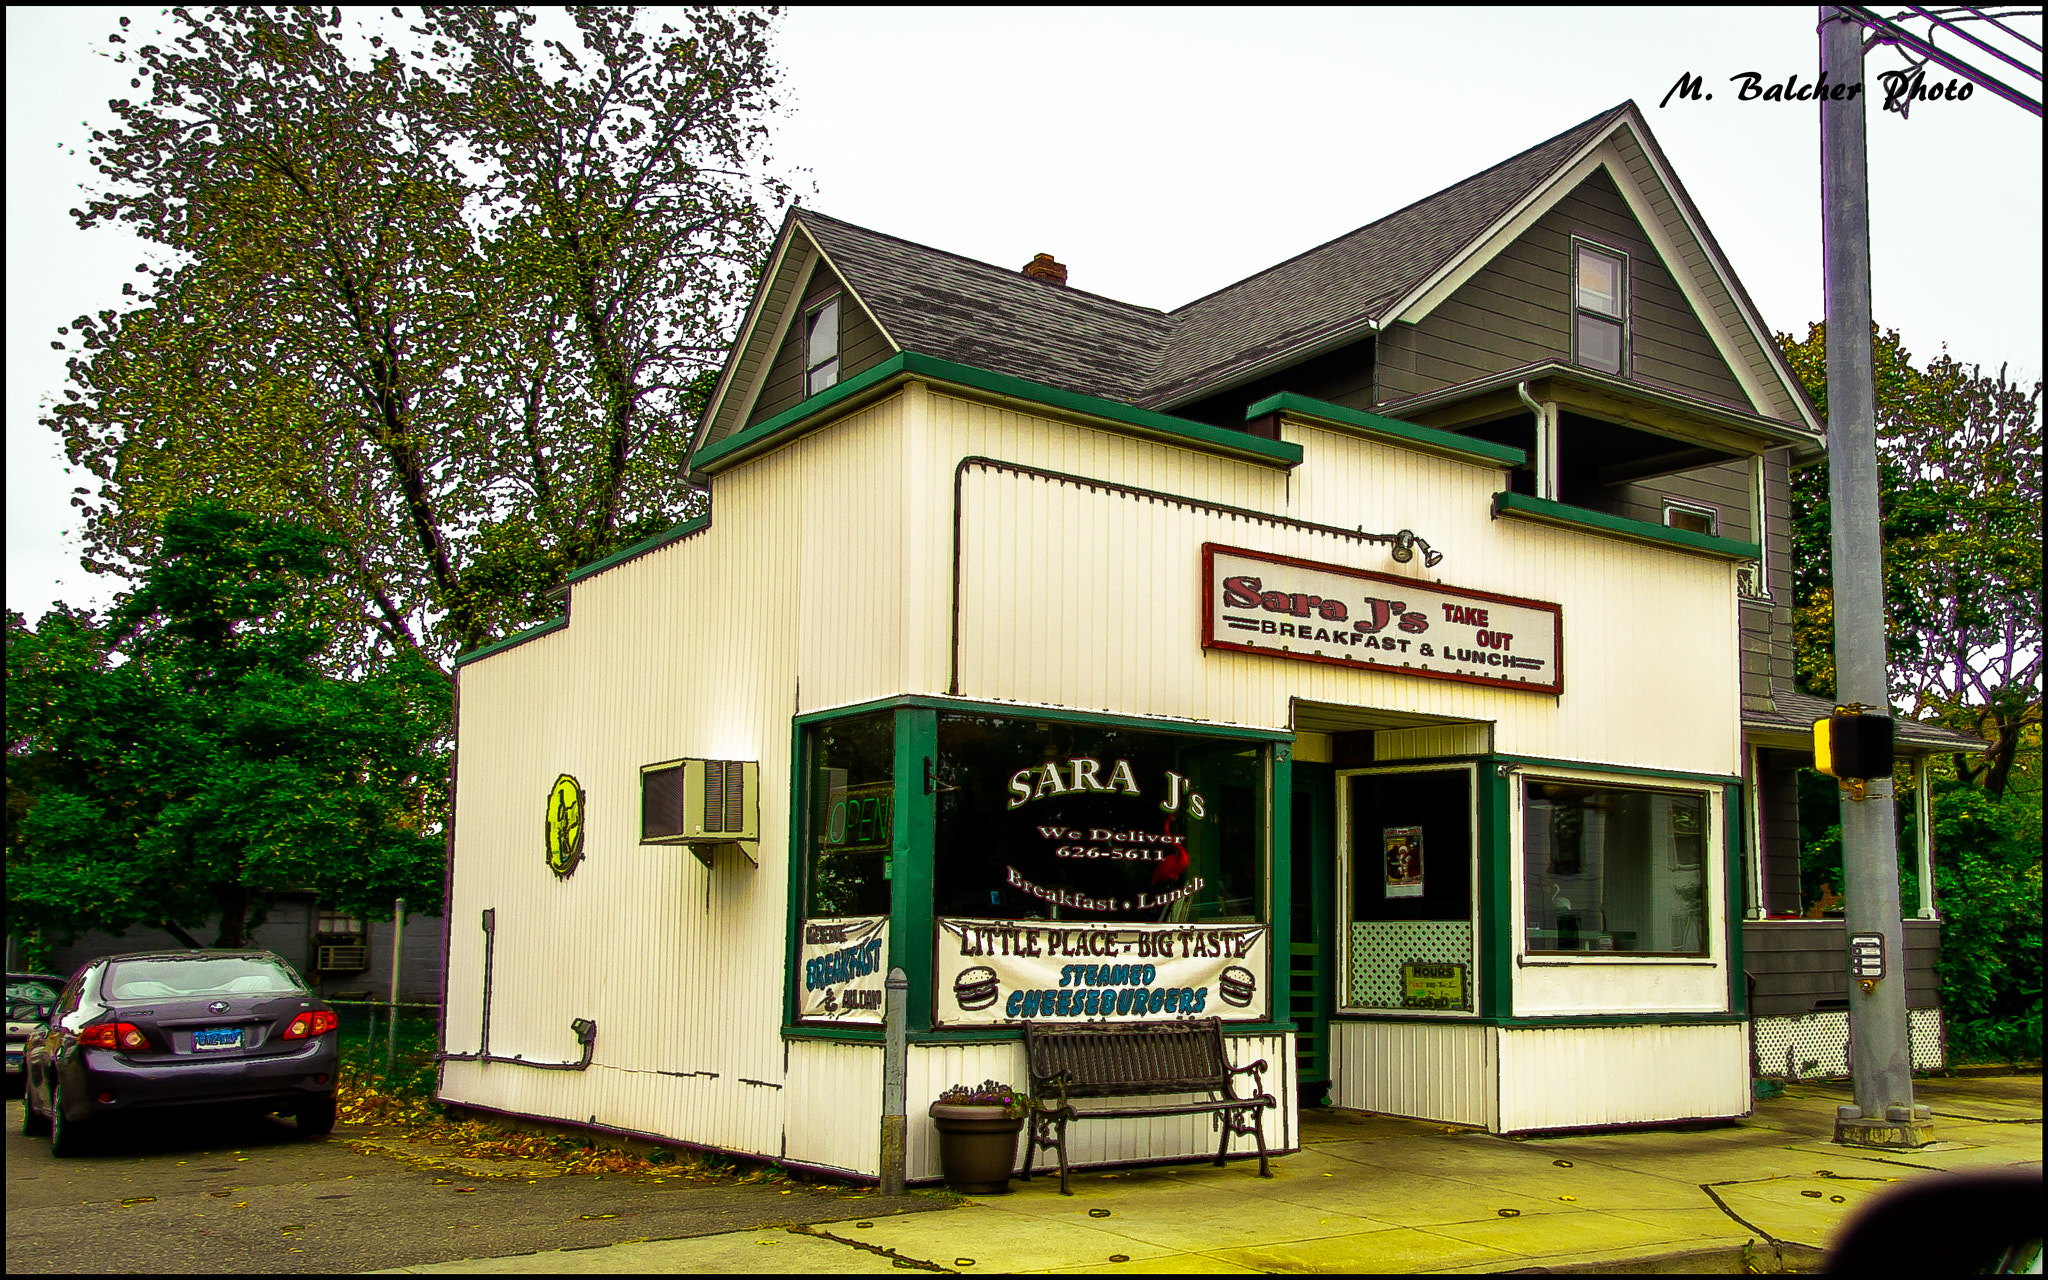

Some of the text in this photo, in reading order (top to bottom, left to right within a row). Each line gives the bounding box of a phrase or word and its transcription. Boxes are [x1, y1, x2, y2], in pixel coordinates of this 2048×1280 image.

[1223, 576, 1430, 634] Sara J's
[1442, 603, 1489, 628] TAKE
[1260, 619, 1517, 669] BREAKFAST & LUNCH
[1476, 628, 1513, 652] OUT
[1007, 757, 1206, 819] SARA J's
[830, 796, 889, 842] OPEN
[1037, 825, 1185, 844] We Deliver
[1055, 846, 1166, 862] 626-5611
[1006, 865, 1206, 912] Breakfast Lunch
[960, 927, 1247, 958] LITTLE PLACE BIG TASTE
[806, 938, 882, 992] BREAKFAST
[1059, 964, 1156, 987] STEAMED
[1413, 967, 1455, 978] HOURS
[1006, 987, 1208, 1018] CHEESEBURGERS
[1405, 997, 1450, 1008] CLOSED
